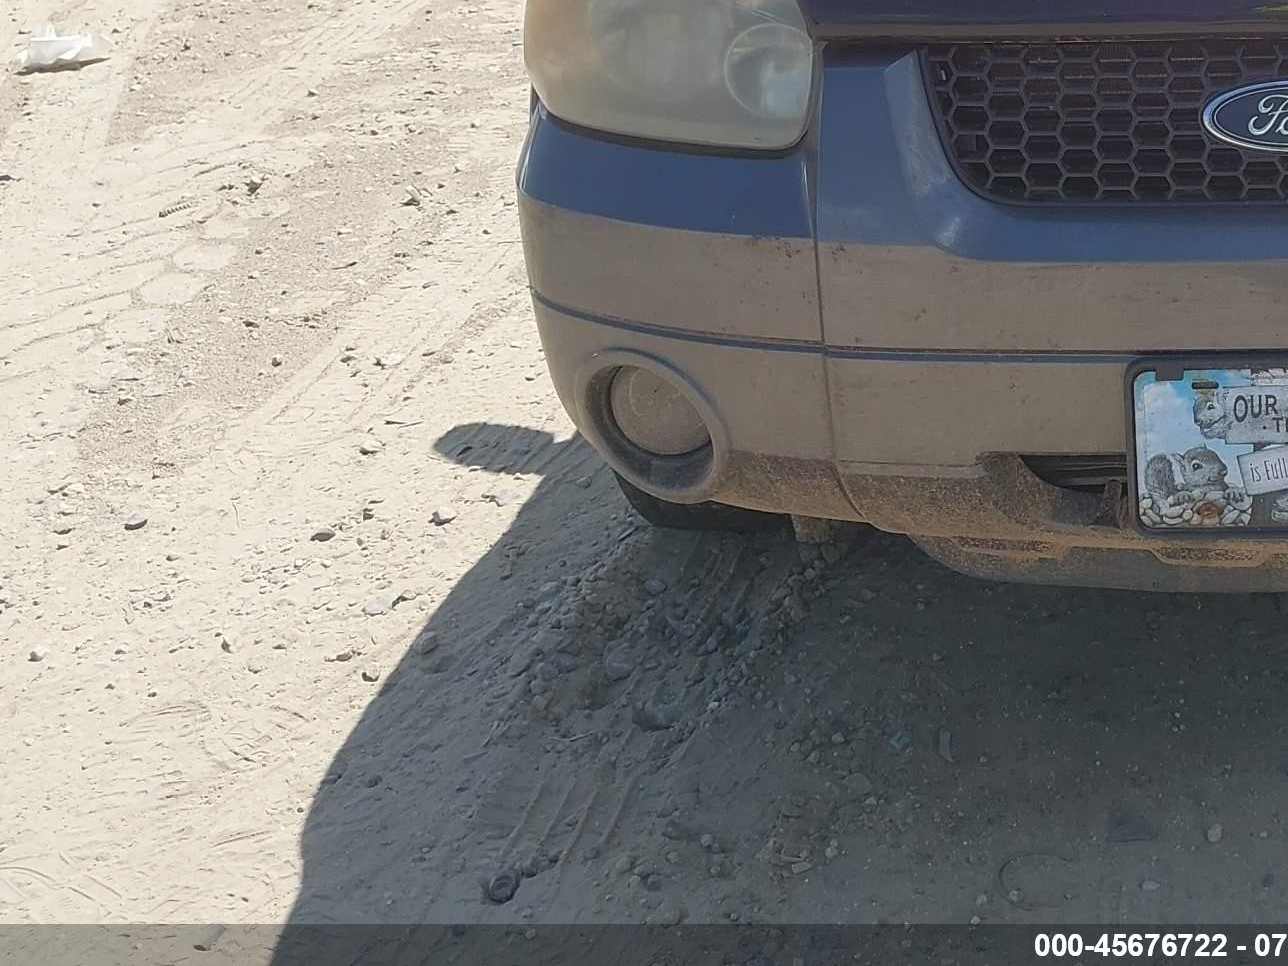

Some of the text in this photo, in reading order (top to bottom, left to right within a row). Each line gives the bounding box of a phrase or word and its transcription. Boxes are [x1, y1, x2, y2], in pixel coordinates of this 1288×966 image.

[1233, 394, 1278, 422] OUR
[1250, 463, 1261, 482] is
[1264, 457, 1288, 480] Full
